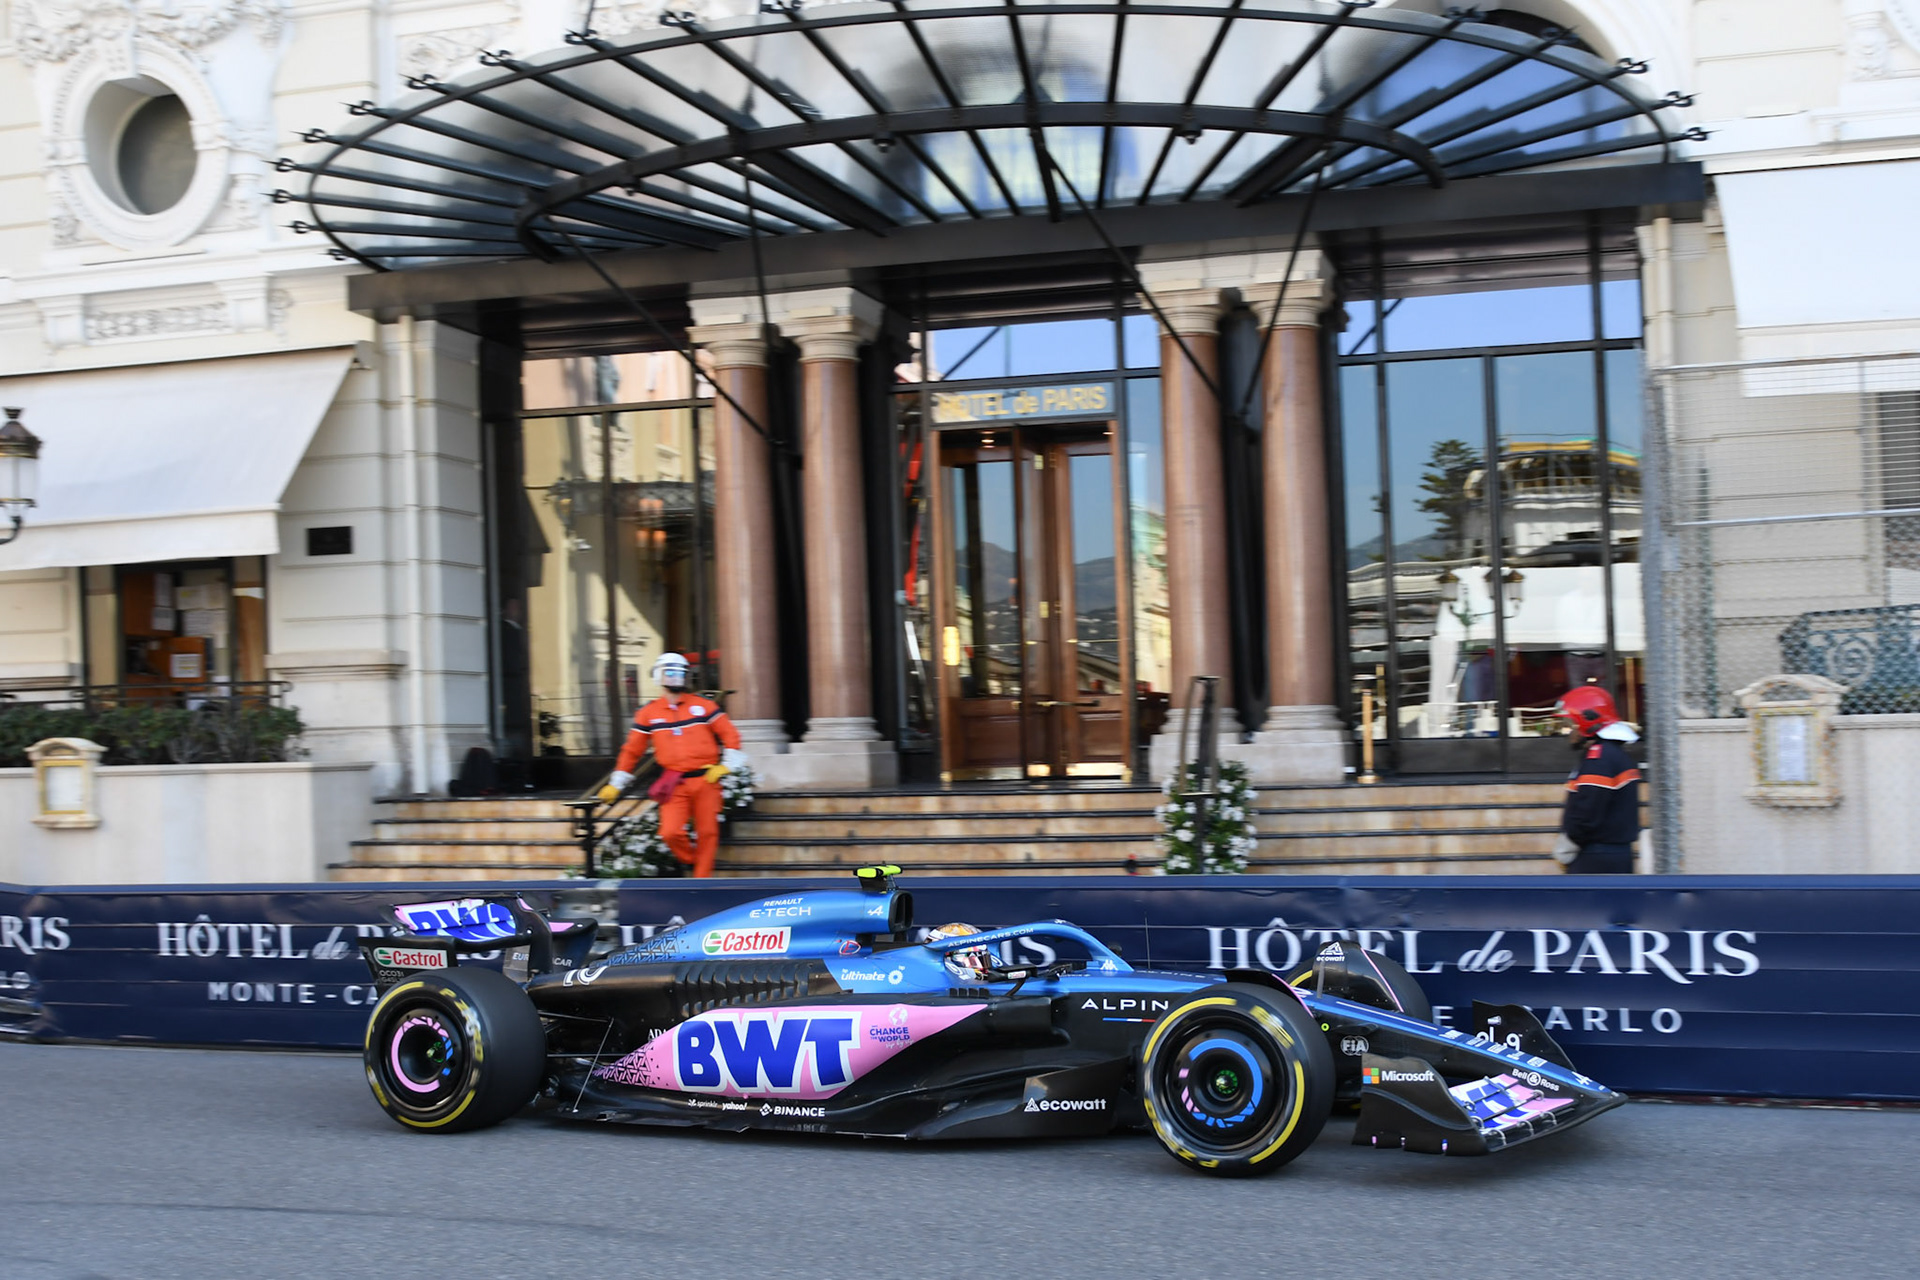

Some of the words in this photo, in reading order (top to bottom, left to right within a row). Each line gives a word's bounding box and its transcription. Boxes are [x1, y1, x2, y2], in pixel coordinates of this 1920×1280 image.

[1013, 390, 1039, 415] de
[1042, 386, 1107, 412] PARIS
[763, 898, 803, 907] RENAULT
[749, 906, 812, 918] E-TECH
[0, 915, 70, 955] RIS
[157, 914, 307, 960] HÔTEL
[313, 926, 349, 960] de
[722, 931, 784, 953] Castrol
[947, 927, 1034, 948] ALPINECARS.COM
[393, 950, 443, 967] Castrol
[1457, 930, 1517, 973] de
[1527, 929, 1760, 985] PARIS
[841, 970, 886, 981] ultimate
[1081, 998, 1169, 1011] ALPIN
[870, 1027, 909, 1036] CHANGE
[678, 1018, 853, 1088] BWT
[1381, 1070, 1435, 1083] Microsoft
[1512, 1068, 1528, 1080] Bell
[1540, 1079, 1560, 1092] Ross
[722, 1101, 748, 1111] yahoo!
[773, 1106, 825, 1117] BINANCE
[1039, 1099, 1107, 1111] ecowatt
